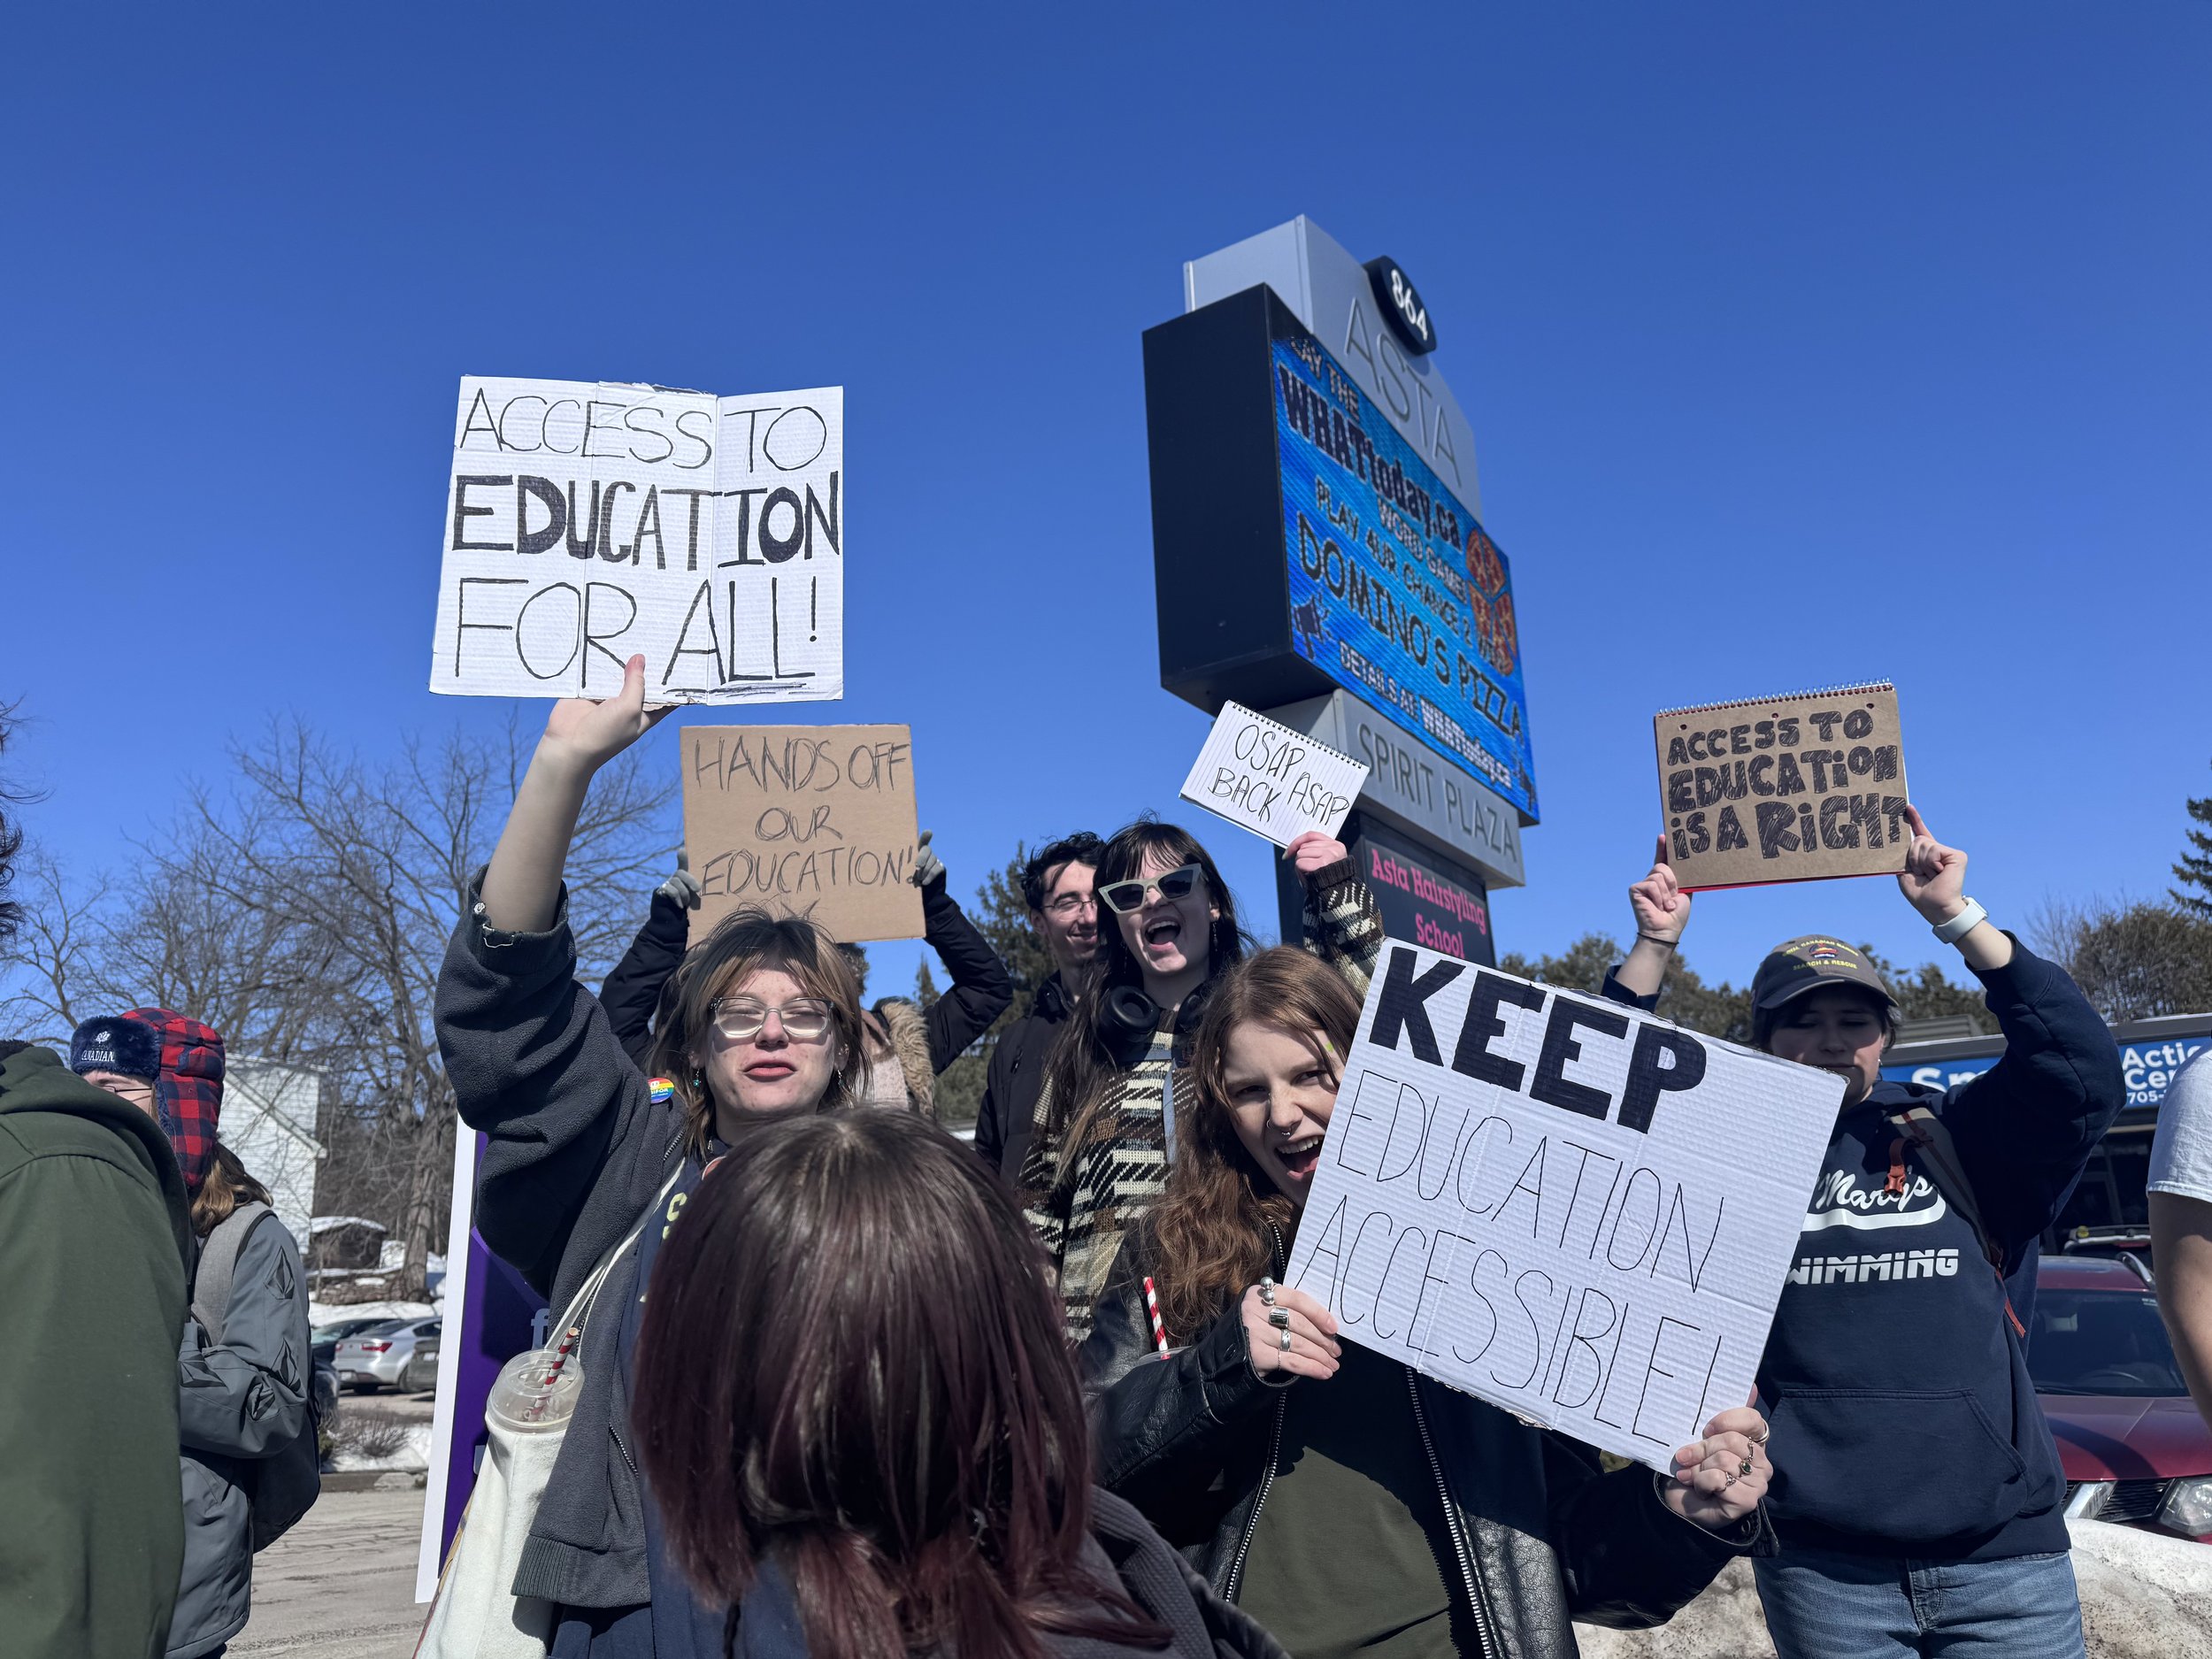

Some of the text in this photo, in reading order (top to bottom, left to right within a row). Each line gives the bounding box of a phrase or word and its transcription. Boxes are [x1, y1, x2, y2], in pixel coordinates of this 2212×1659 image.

[1391, 269, 1428, 341] 864
[1326, 362, 1360, 421] THE
[1344, 296, 1462, 488] ASTA
[459, 387, 827, 473] ACCESS TO
[452, 471, 840, 571] EDUCATION
[1316, 476, 1358, 541] PLAY
[454, 576, 818, 689] FOR ALL!
[1296, 511, 1525, 749] DOMINO'S PIZZA
[1339, 640, 1397, 705] DETAILS
[695, 734, 910, 793] HANDS OFF
[1234, 724, 1306, 782] OSAP
[1667, 709, 1874, 766] ACCESS TO
[755, 804, 843, 843] OUR
[1208, 767, 1350, 826] BACK ASAP
[1358, 723, 1517, 864] SPIRIT PLAZA
[1716, 805, 1749, 852] A
[700, 845, 916, 898] EDUCATION!
[1371, 849, 1486, 935] Asta Hairstyling
[1416, 912, 1465, 959] School
[1368, 946, 1707, 1133] KEEP
[1336, 1070, 1724, 1293] EDUCATION
[1786, 1248, 1959, 1285] WIMMING
